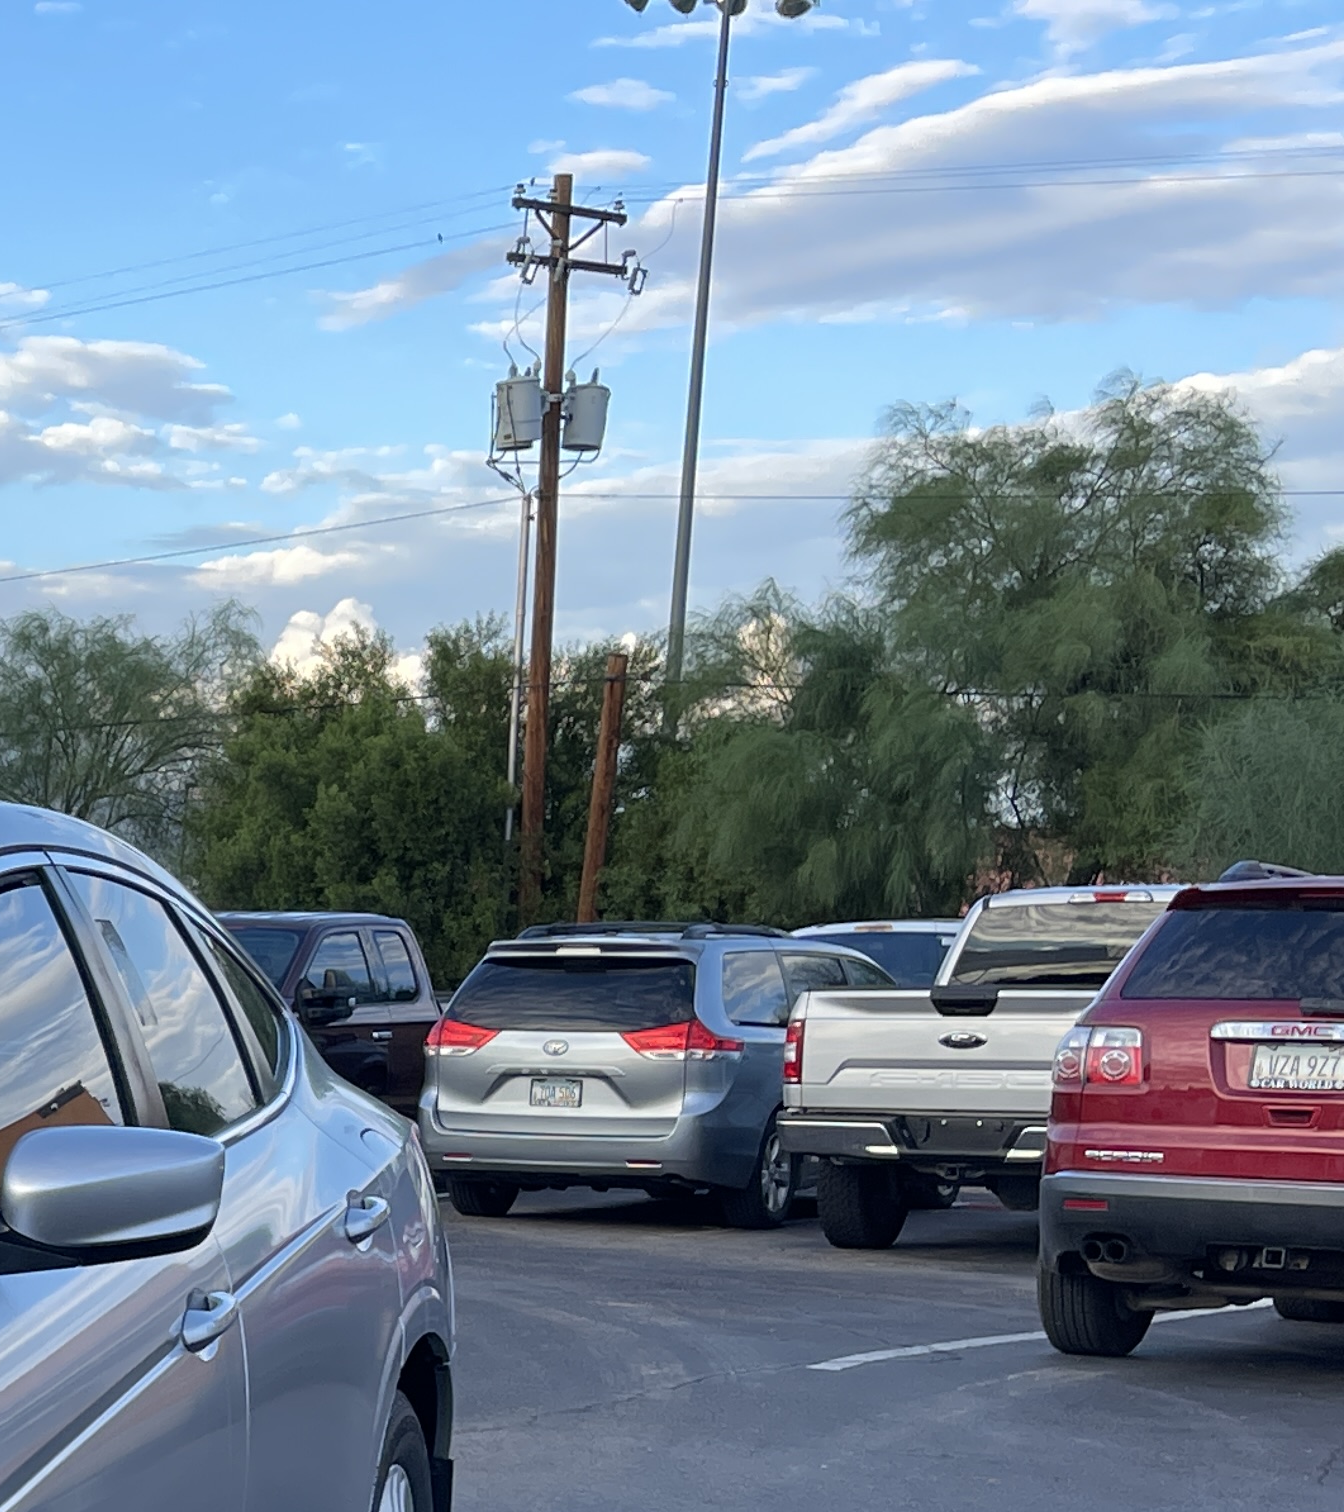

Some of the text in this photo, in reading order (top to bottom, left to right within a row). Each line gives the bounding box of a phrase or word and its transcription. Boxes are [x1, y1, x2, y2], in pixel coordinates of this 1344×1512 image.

[1271, 1025, 1335, 1037] GMC
[1268, 1055, 1341, 1077] VZA 9Z7
[1260, 1078, 1333, 1090] CAR WORLD
